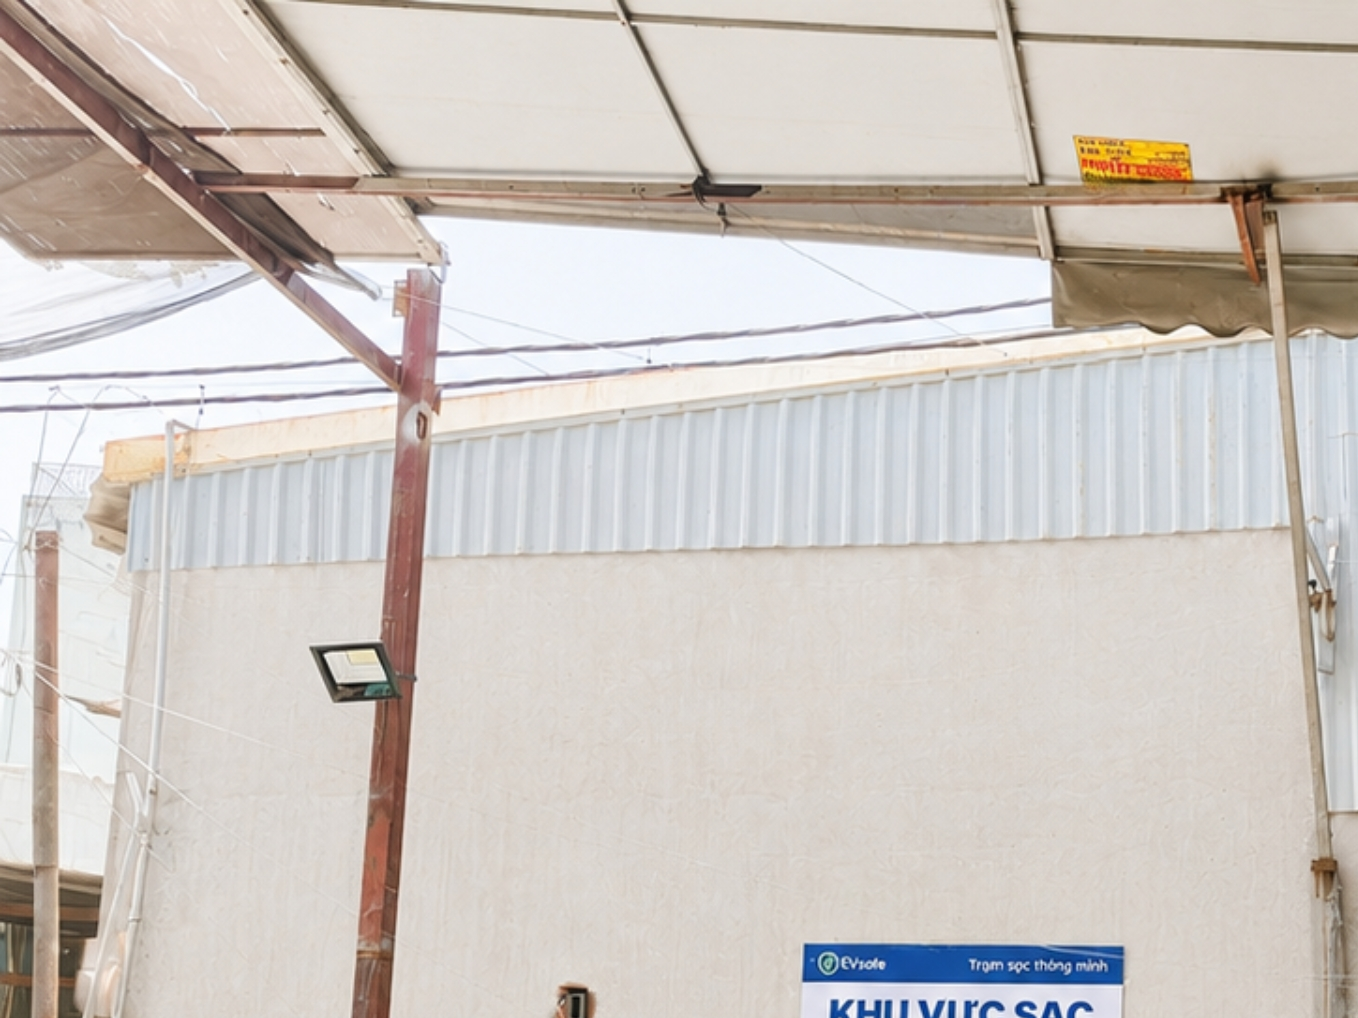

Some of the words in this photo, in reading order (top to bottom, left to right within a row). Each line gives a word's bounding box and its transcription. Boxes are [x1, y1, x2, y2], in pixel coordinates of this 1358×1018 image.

[968, 958, 1004, 974] Trạm
[1007, 960, 1030, 974] sạc
[1034, 958, 1072, 975] thông
[1075, 958, 1109, 973] minh
